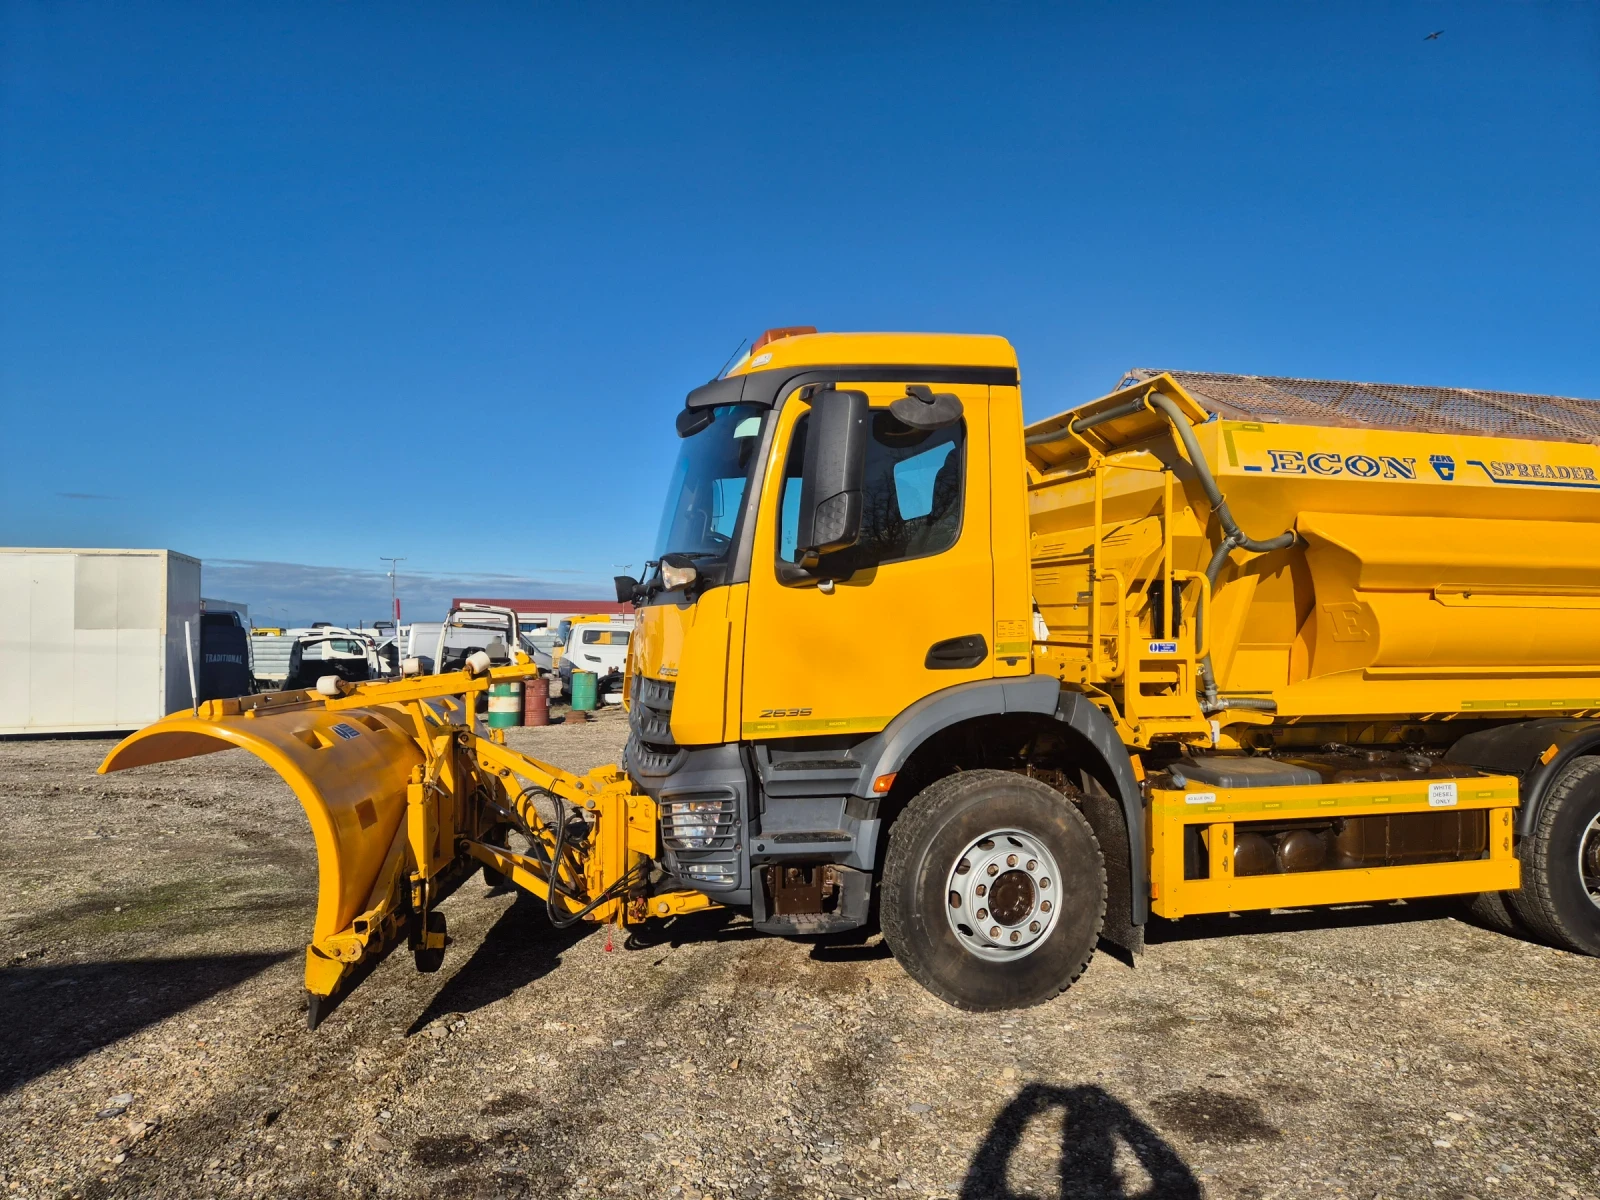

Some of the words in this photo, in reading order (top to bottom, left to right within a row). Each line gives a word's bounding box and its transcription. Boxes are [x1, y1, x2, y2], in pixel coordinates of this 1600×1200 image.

[1267, 450, 1417, 480] ECON
[1490, 460, 1598, 481] SPREADER
[205, 653, 242, 664] TRADITIONAL
[759, 708, 812, 718] 2635
